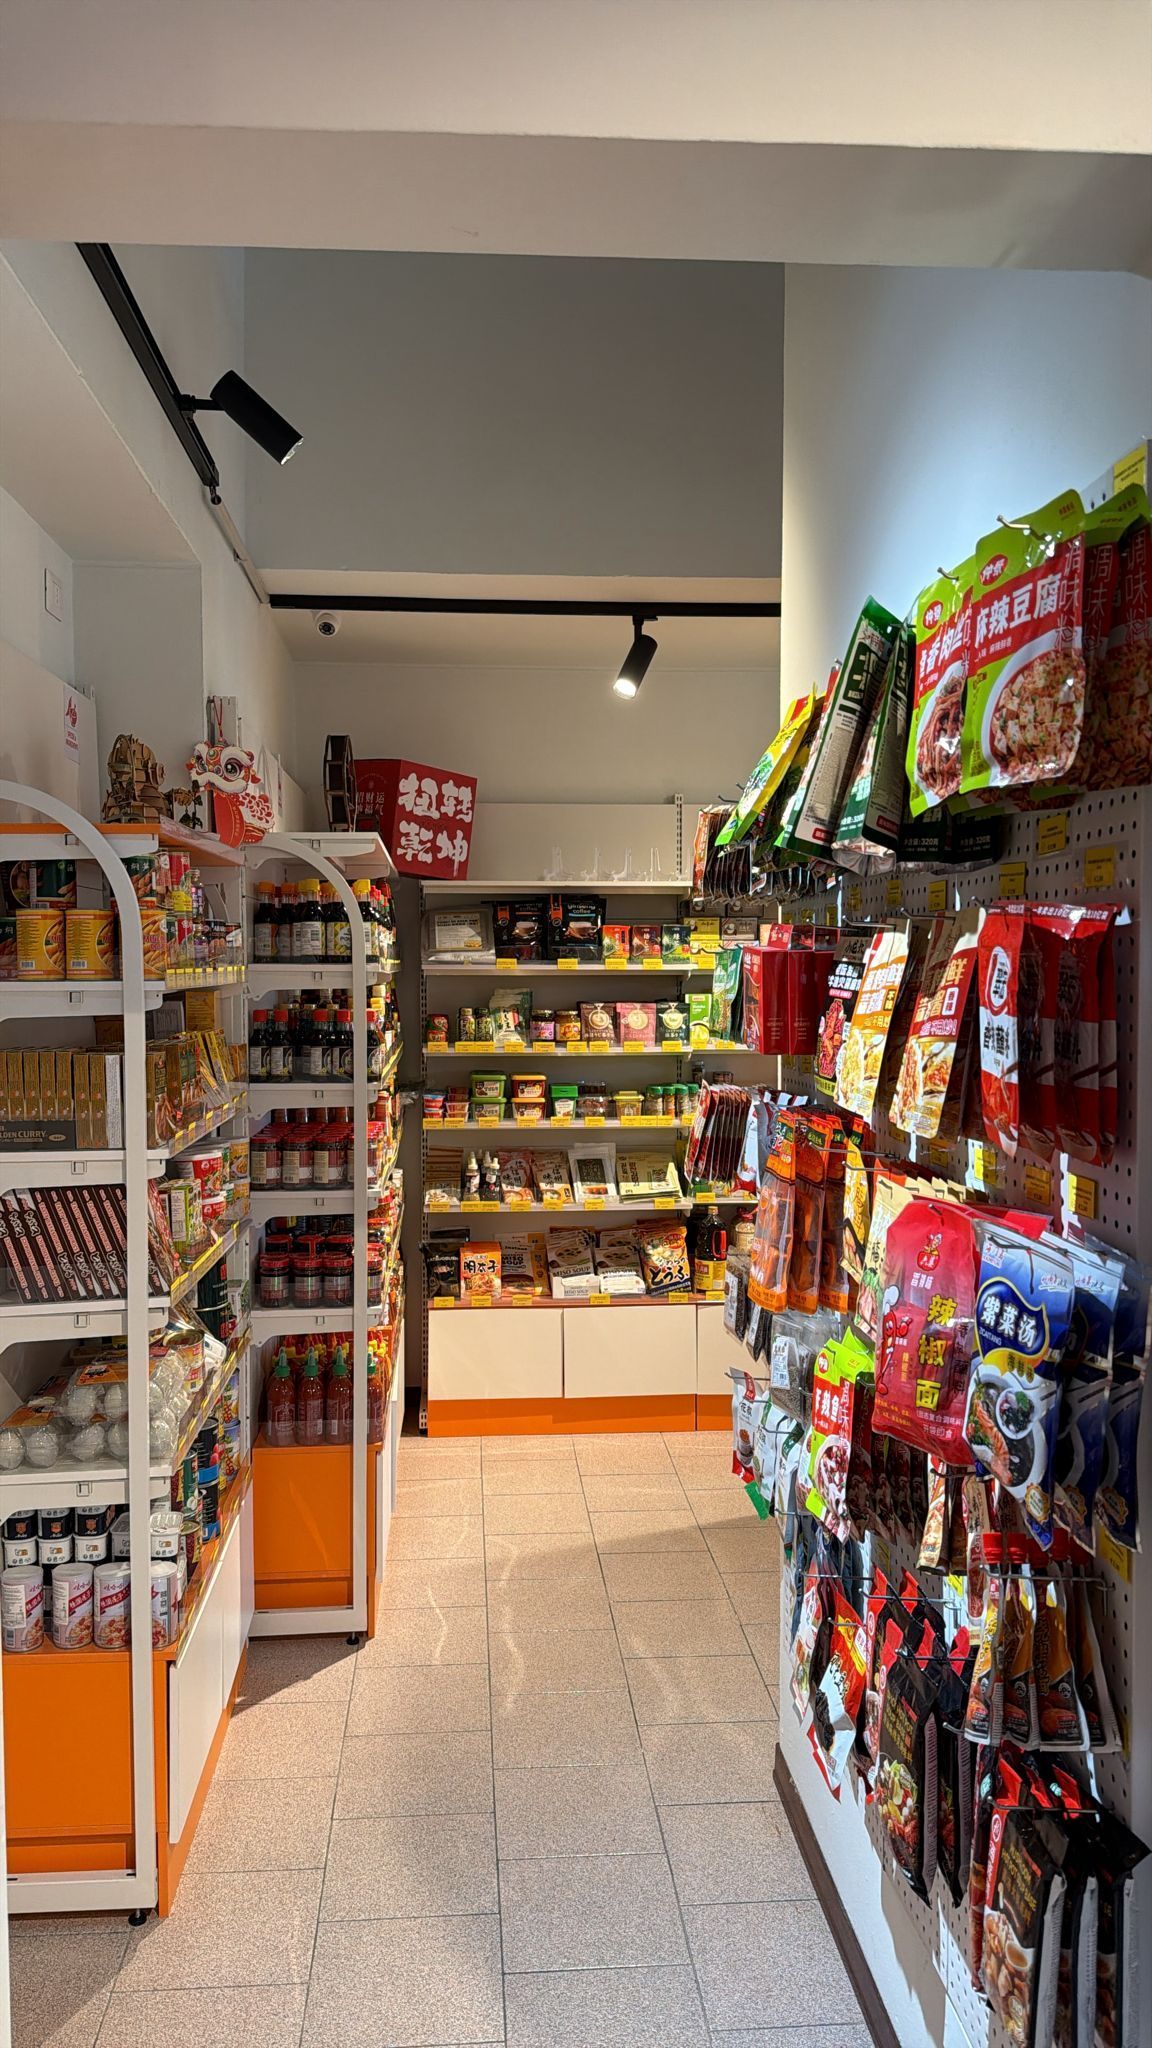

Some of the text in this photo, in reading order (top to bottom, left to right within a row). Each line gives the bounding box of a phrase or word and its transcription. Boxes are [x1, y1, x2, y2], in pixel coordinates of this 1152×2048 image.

[398, 772, 472, 823] 扭转
[18, 1130, 47, 1138] CURRY
[463, 1259, 498, 1274] 明太子
[553, 1265, 591, 1277] MISO SOUP
[979, 1295, 1037, 1351] 紫菜汤
[915, 1294, 957, 1412] 辣椒面
